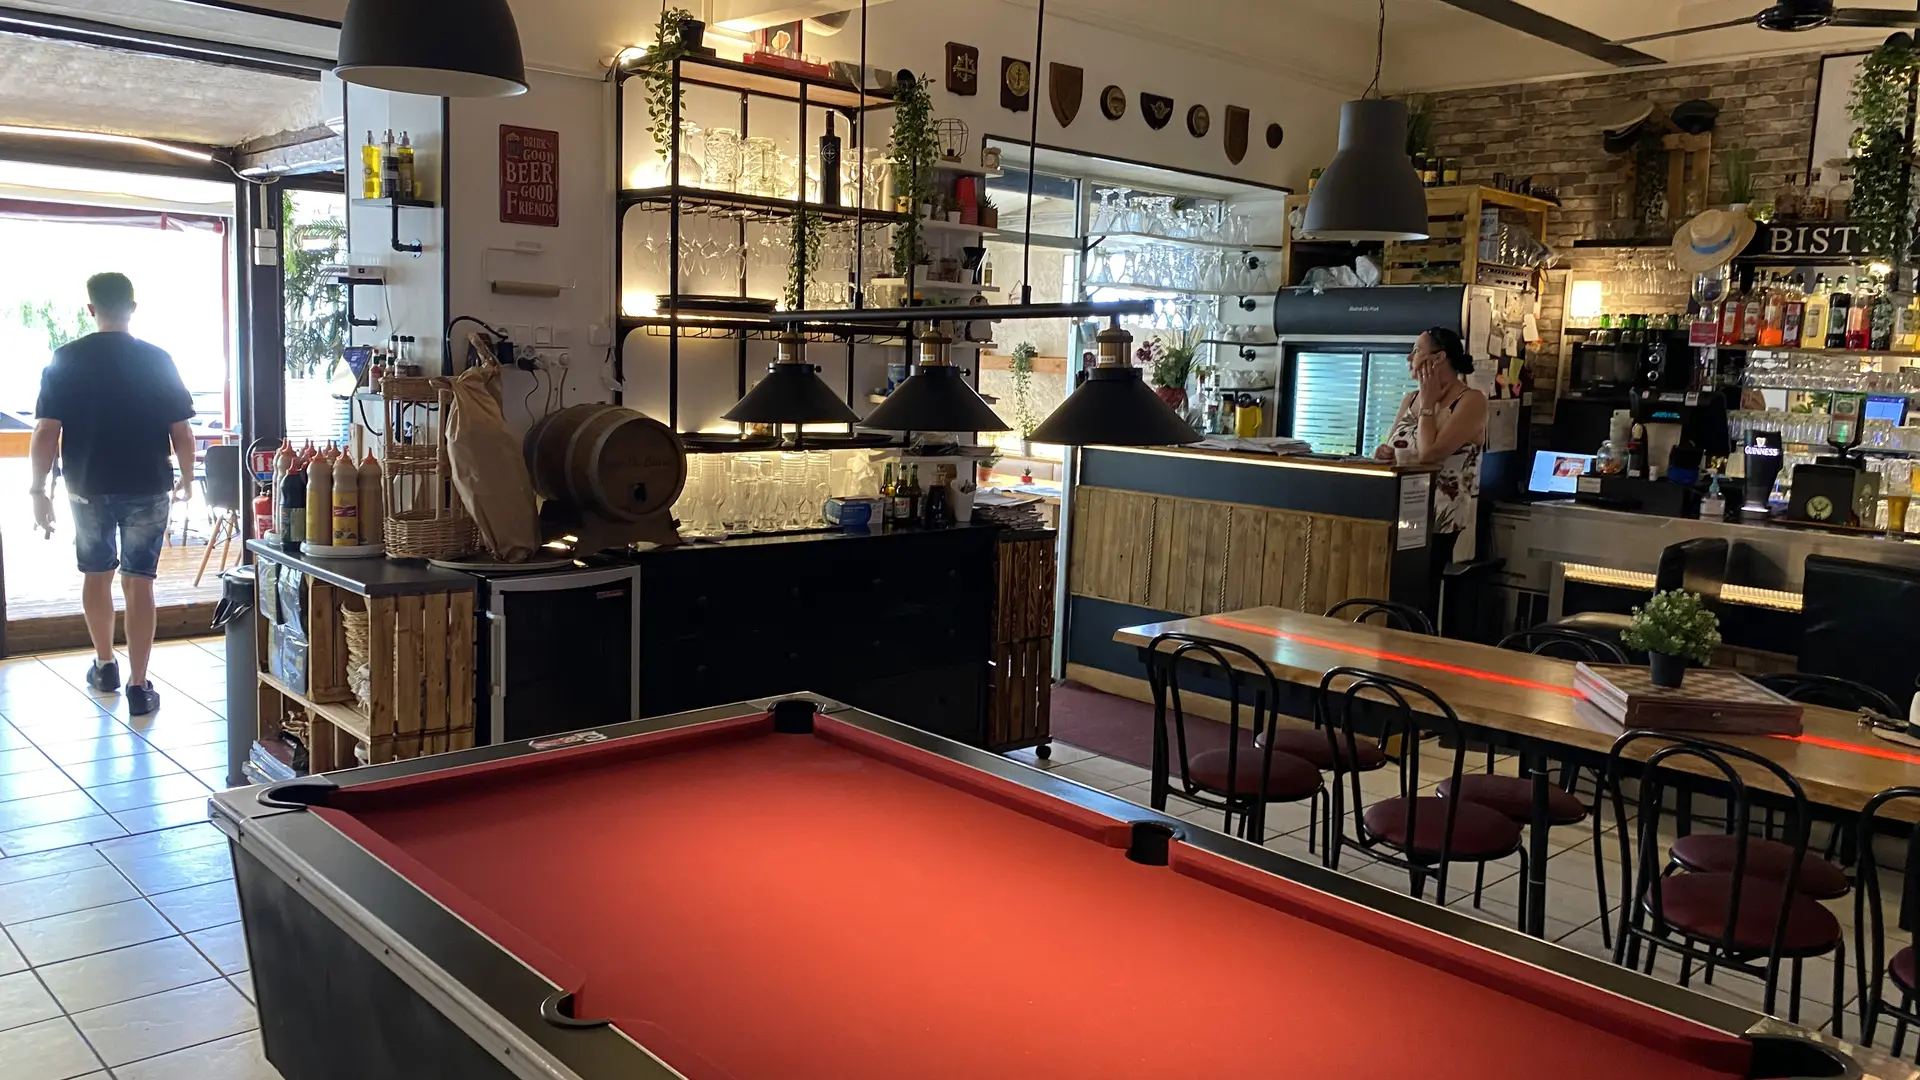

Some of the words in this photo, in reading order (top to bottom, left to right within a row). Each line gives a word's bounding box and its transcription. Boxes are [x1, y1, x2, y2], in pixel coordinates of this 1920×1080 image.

[523, 149, 554, 164] GOOD
[506, 161, 553, 184] BEER
[520, 184, 553, 203] GOOD
[506, 190, 555, 217] FRIENDS
[1744, 446, 1779, 457] GUINNESS
